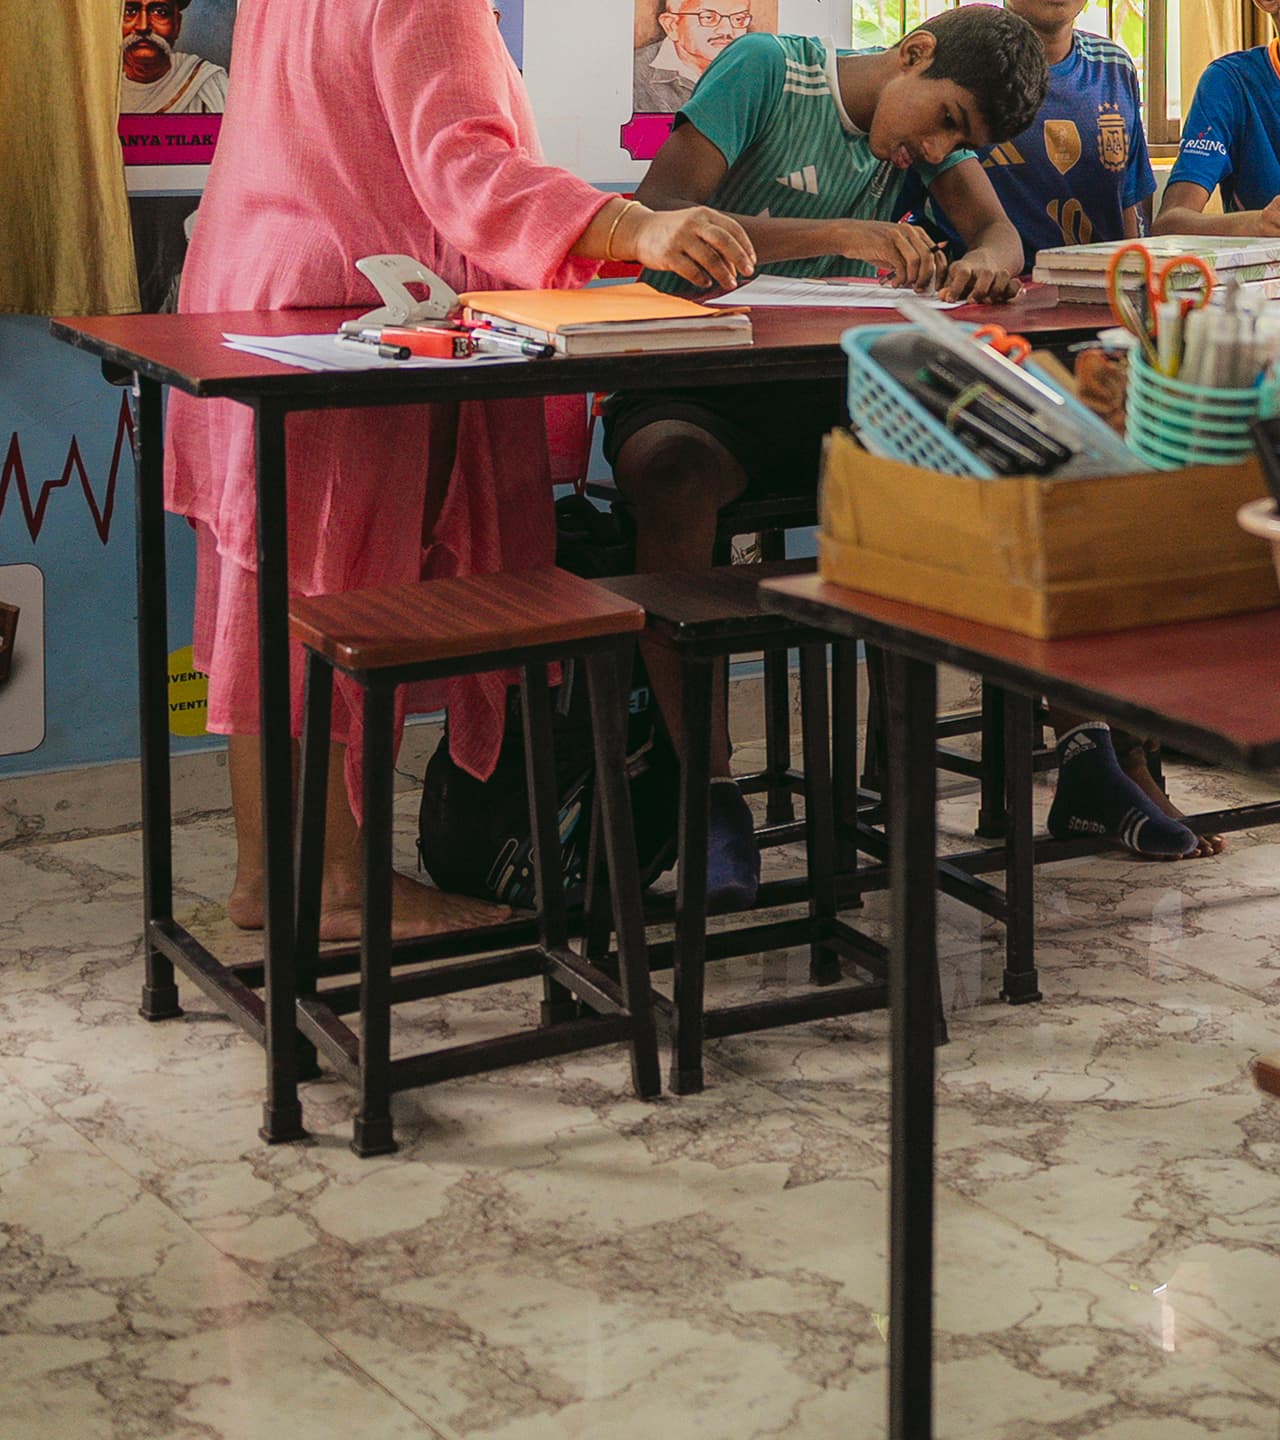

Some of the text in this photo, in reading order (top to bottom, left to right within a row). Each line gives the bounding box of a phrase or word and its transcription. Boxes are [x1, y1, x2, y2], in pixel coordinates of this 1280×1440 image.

[119, 134, 214, 147] ANYA TILAK
[1185, 139, 1227, 156] RISING
